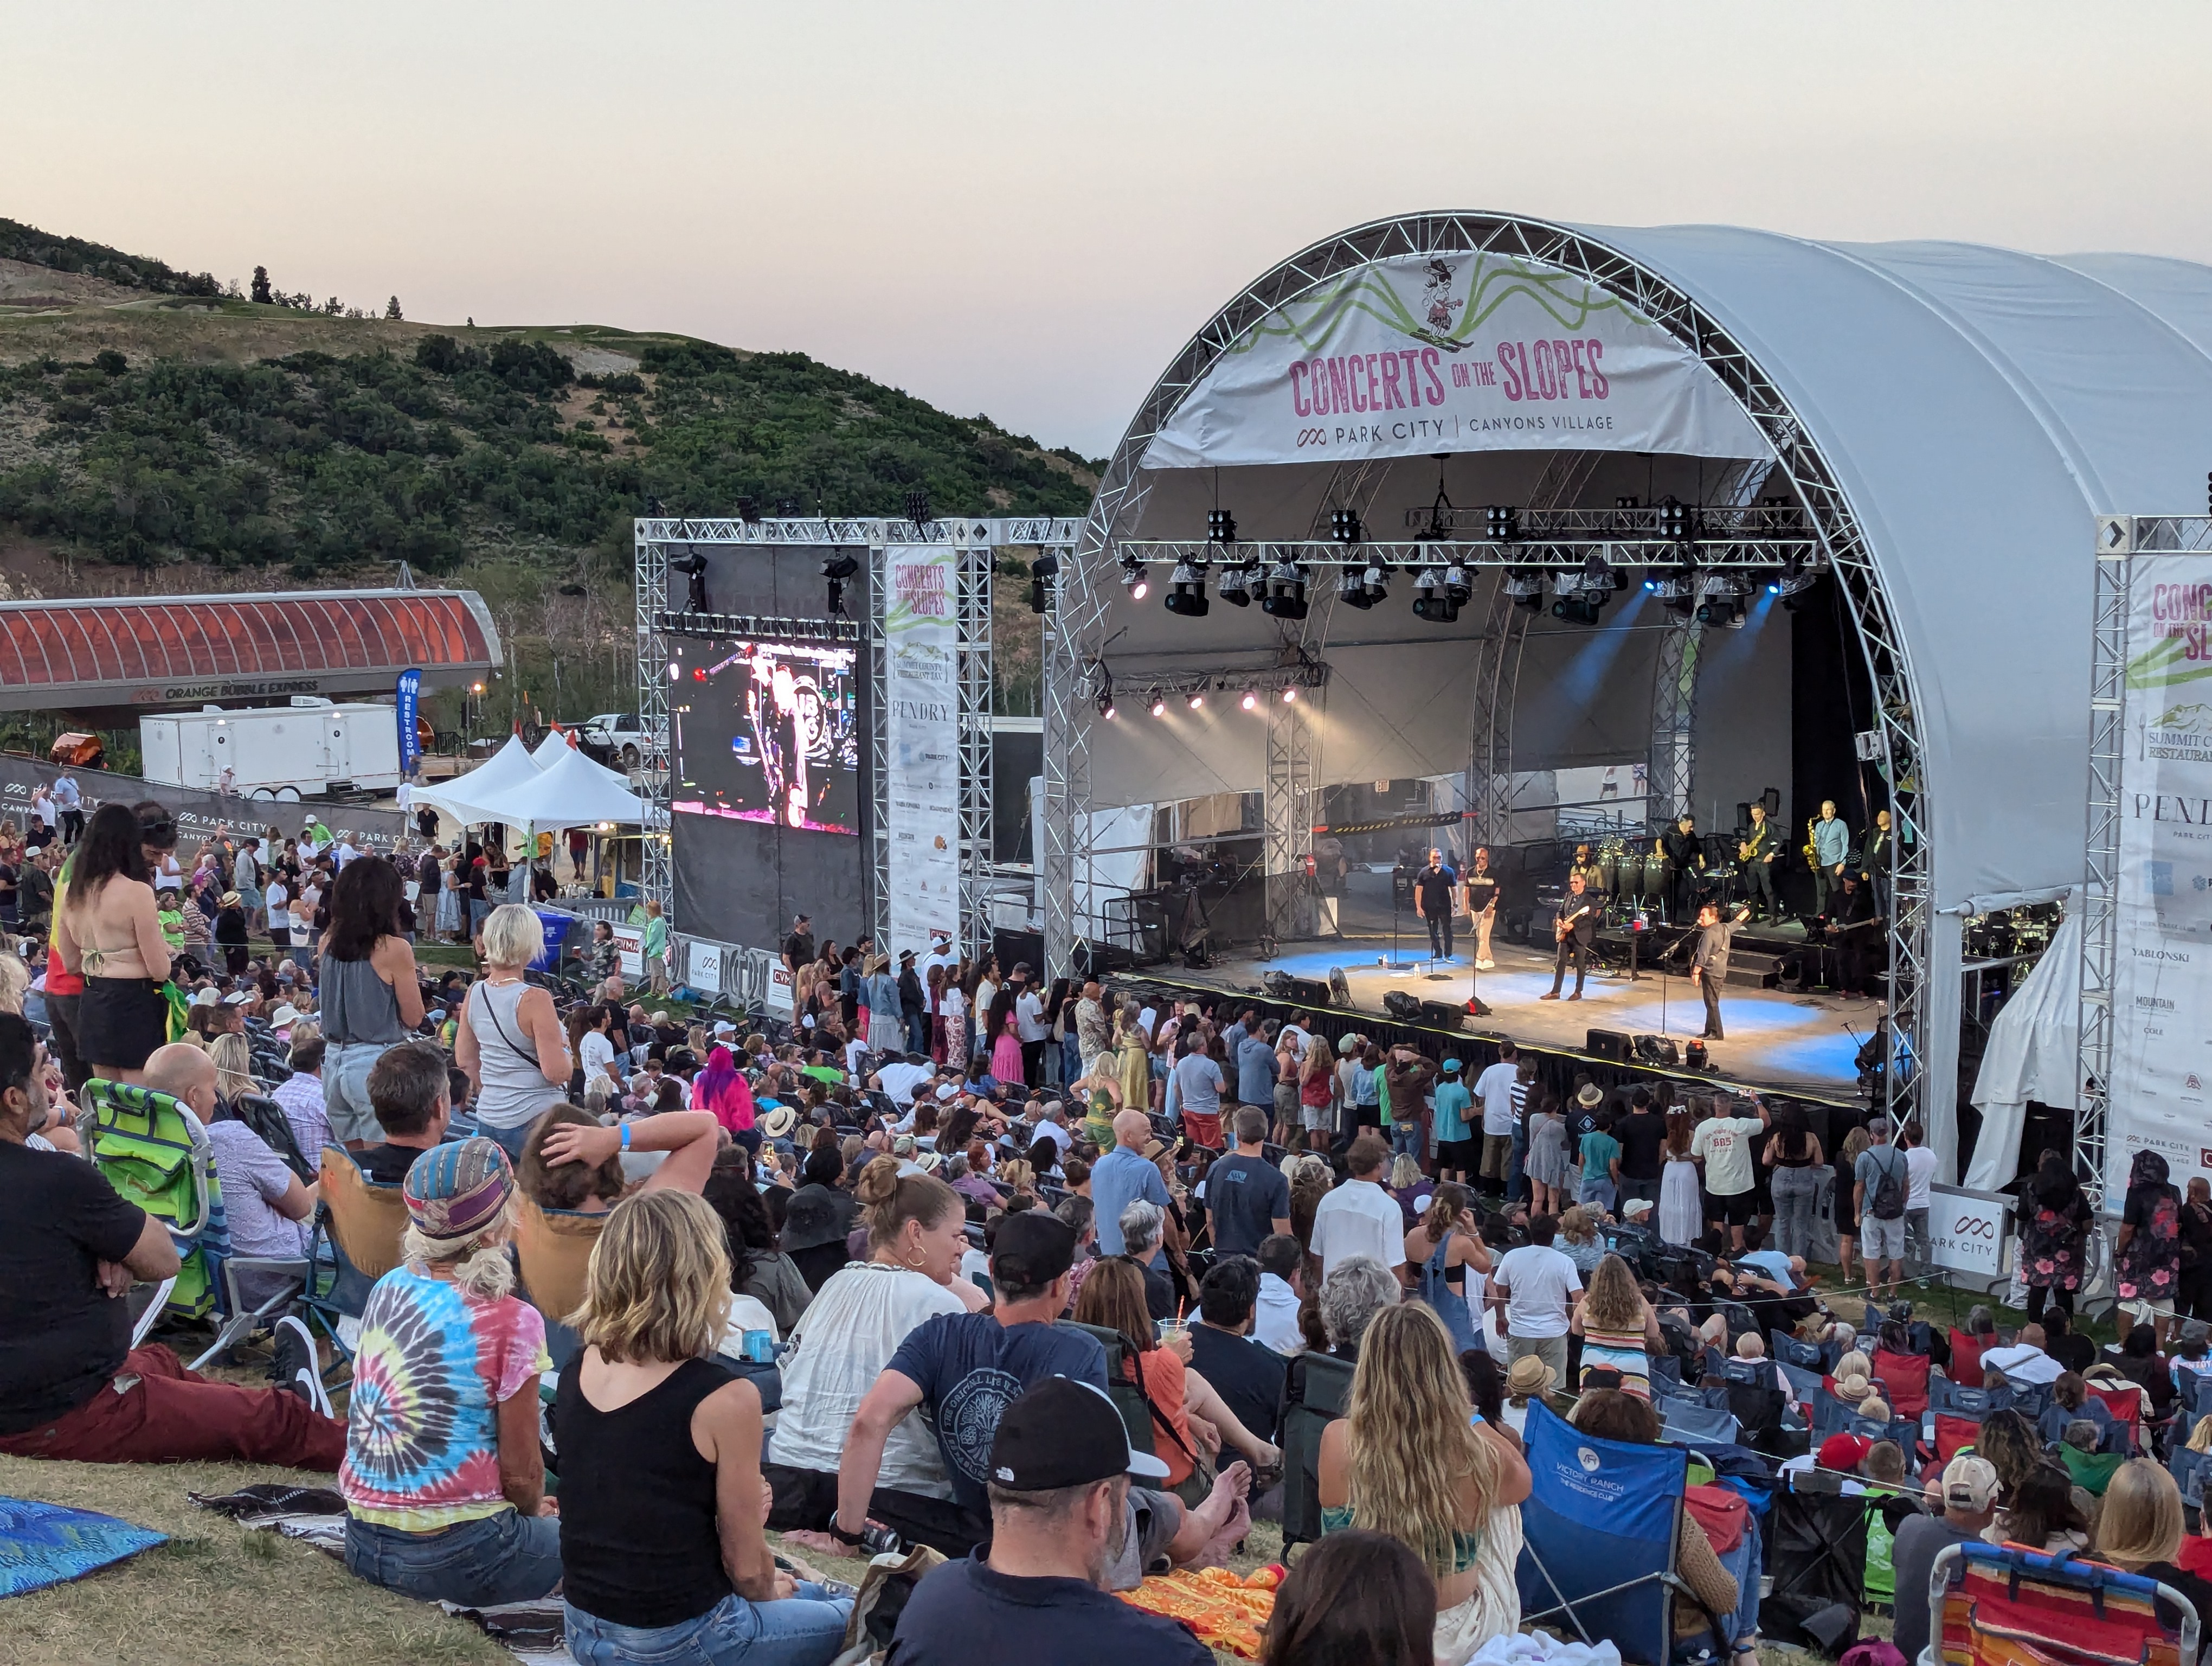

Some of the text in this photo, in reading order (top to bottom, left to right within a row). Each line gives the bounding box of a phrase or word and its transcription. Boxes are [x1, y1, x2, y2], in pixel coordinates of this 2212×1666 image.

[1289, 339, 1609, 417] CONCERTS ON THE SLOPES
[1336, 416, 1613, 444] PARK CITY CANYONS VILLAGE
[896, 564, 944, 589] CONCERTS
[911, 589, 944, 616] SLOPES
[2153, 584, 2212, 621] CONC
[2185, 623, 2212, 661] SL
[165, 680, 319, 700] ORANGE BUBBLE EXPRESS
[892, 700, 949, 722] PENDRY
[404, 695, 415, 763] RESTROOM
[2149, 732, 2201, 747] SUMMIT
[239, 822, 267, 832] CITY
[359, 831, 420, 845] PARK CTY
[2131, 948, 2190, 963] YABLONSKI
[774, 971, 791, 984] CVM
[2136, 996, 2175, 1010] MOUNTAIN
[1930, 1237, 1993, 1256] ARK CITY
